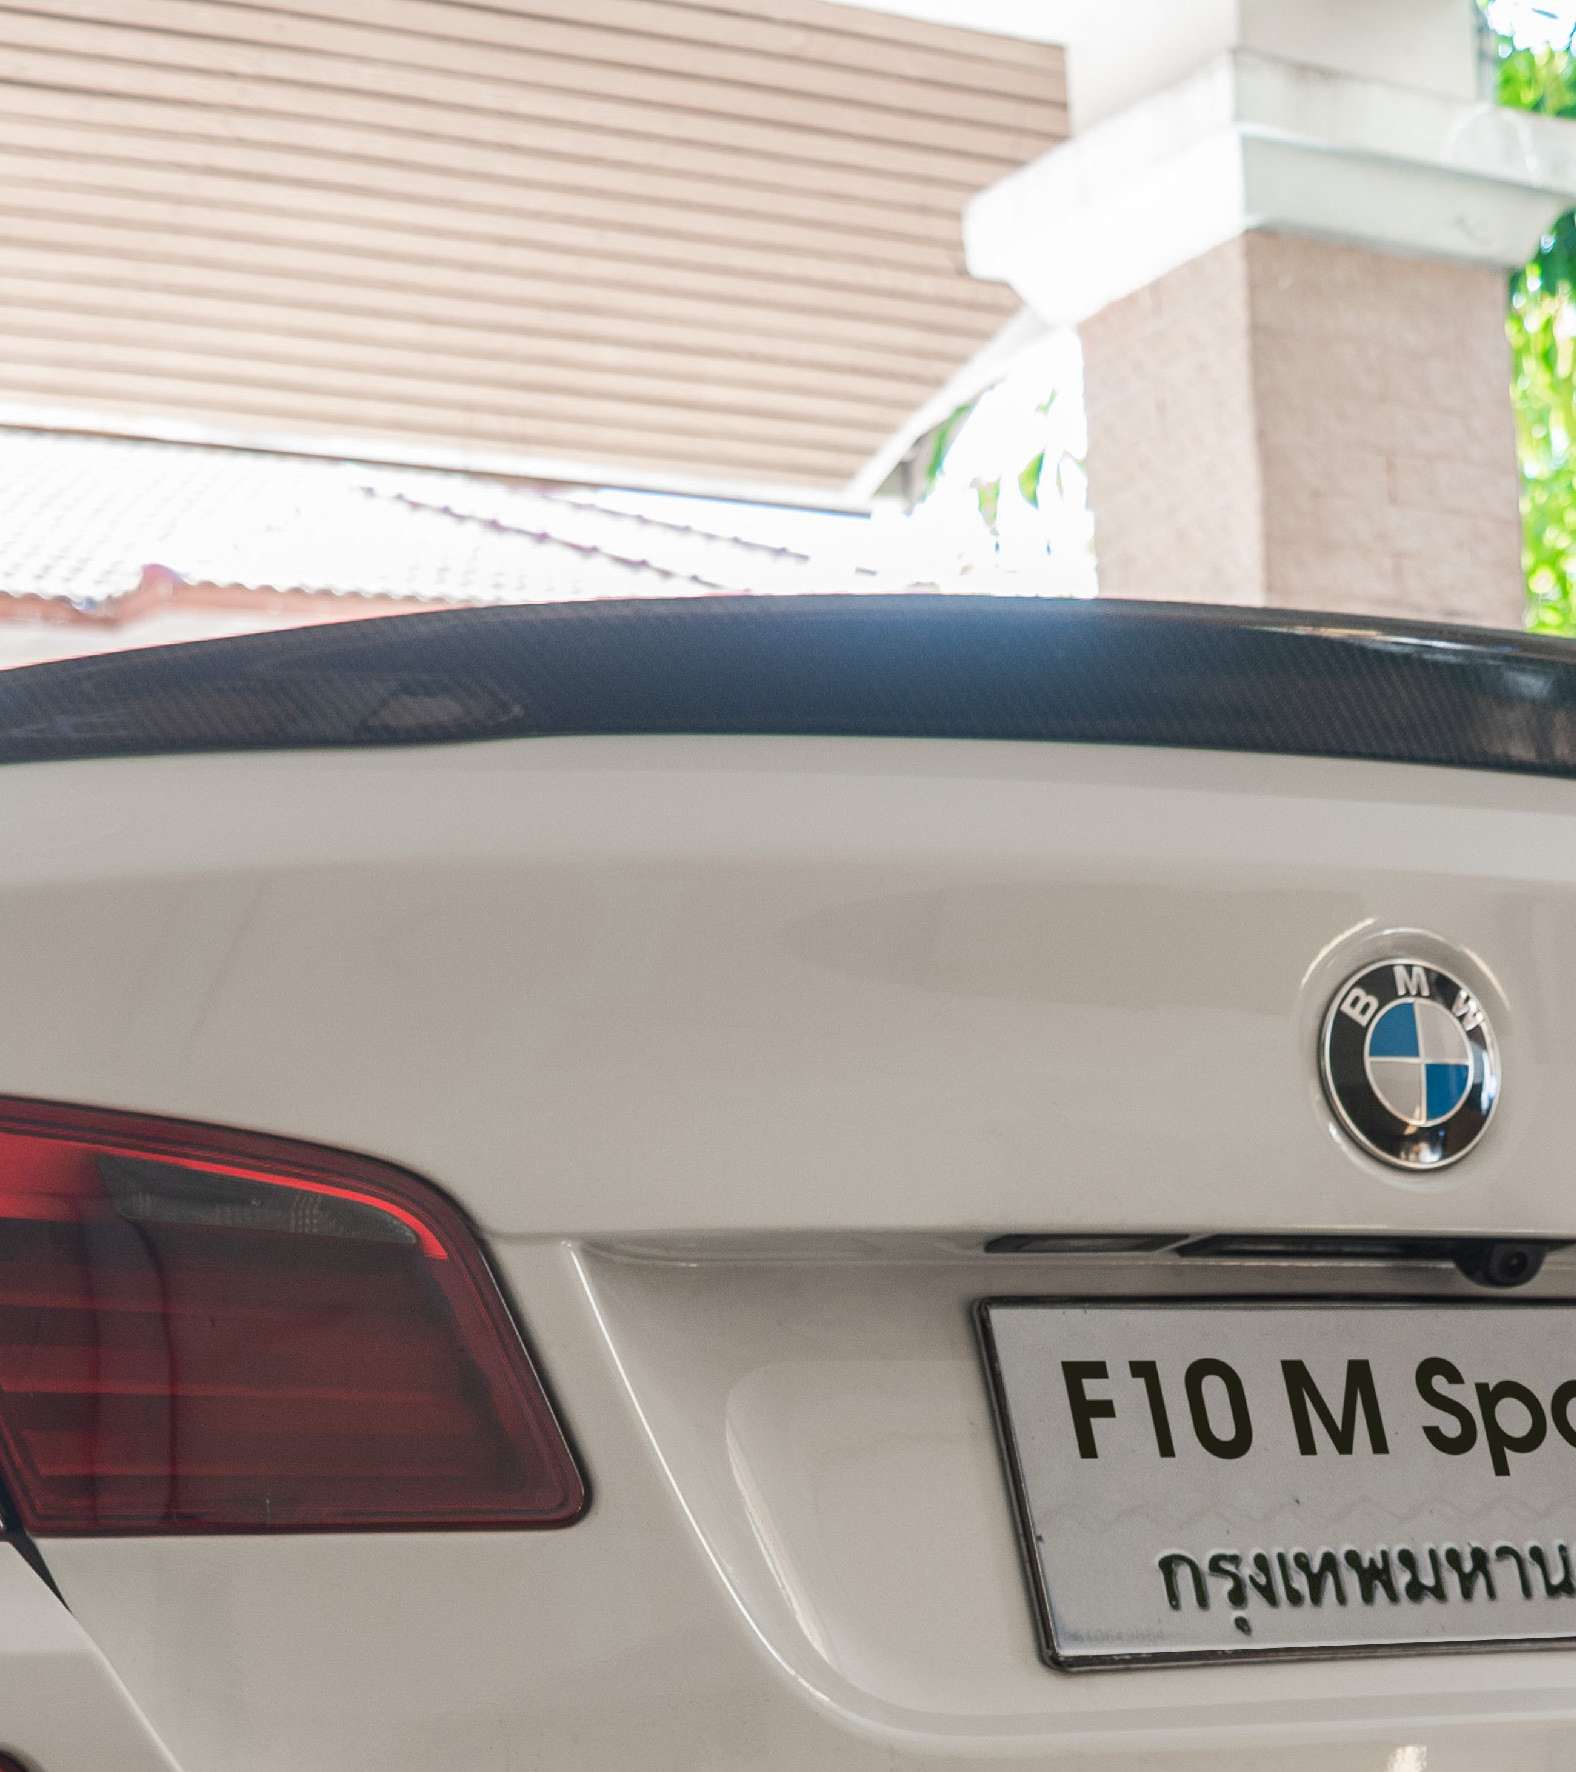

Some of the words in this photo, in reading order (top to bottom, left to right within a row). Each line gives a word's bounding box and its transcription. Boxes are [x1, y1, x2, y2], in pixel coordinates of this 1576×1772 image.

[1339, 963, 1485, 1032] BMW
[1061, 1357, 1253, 1459] F10
[1280, 1359, 1389, 1455] M
